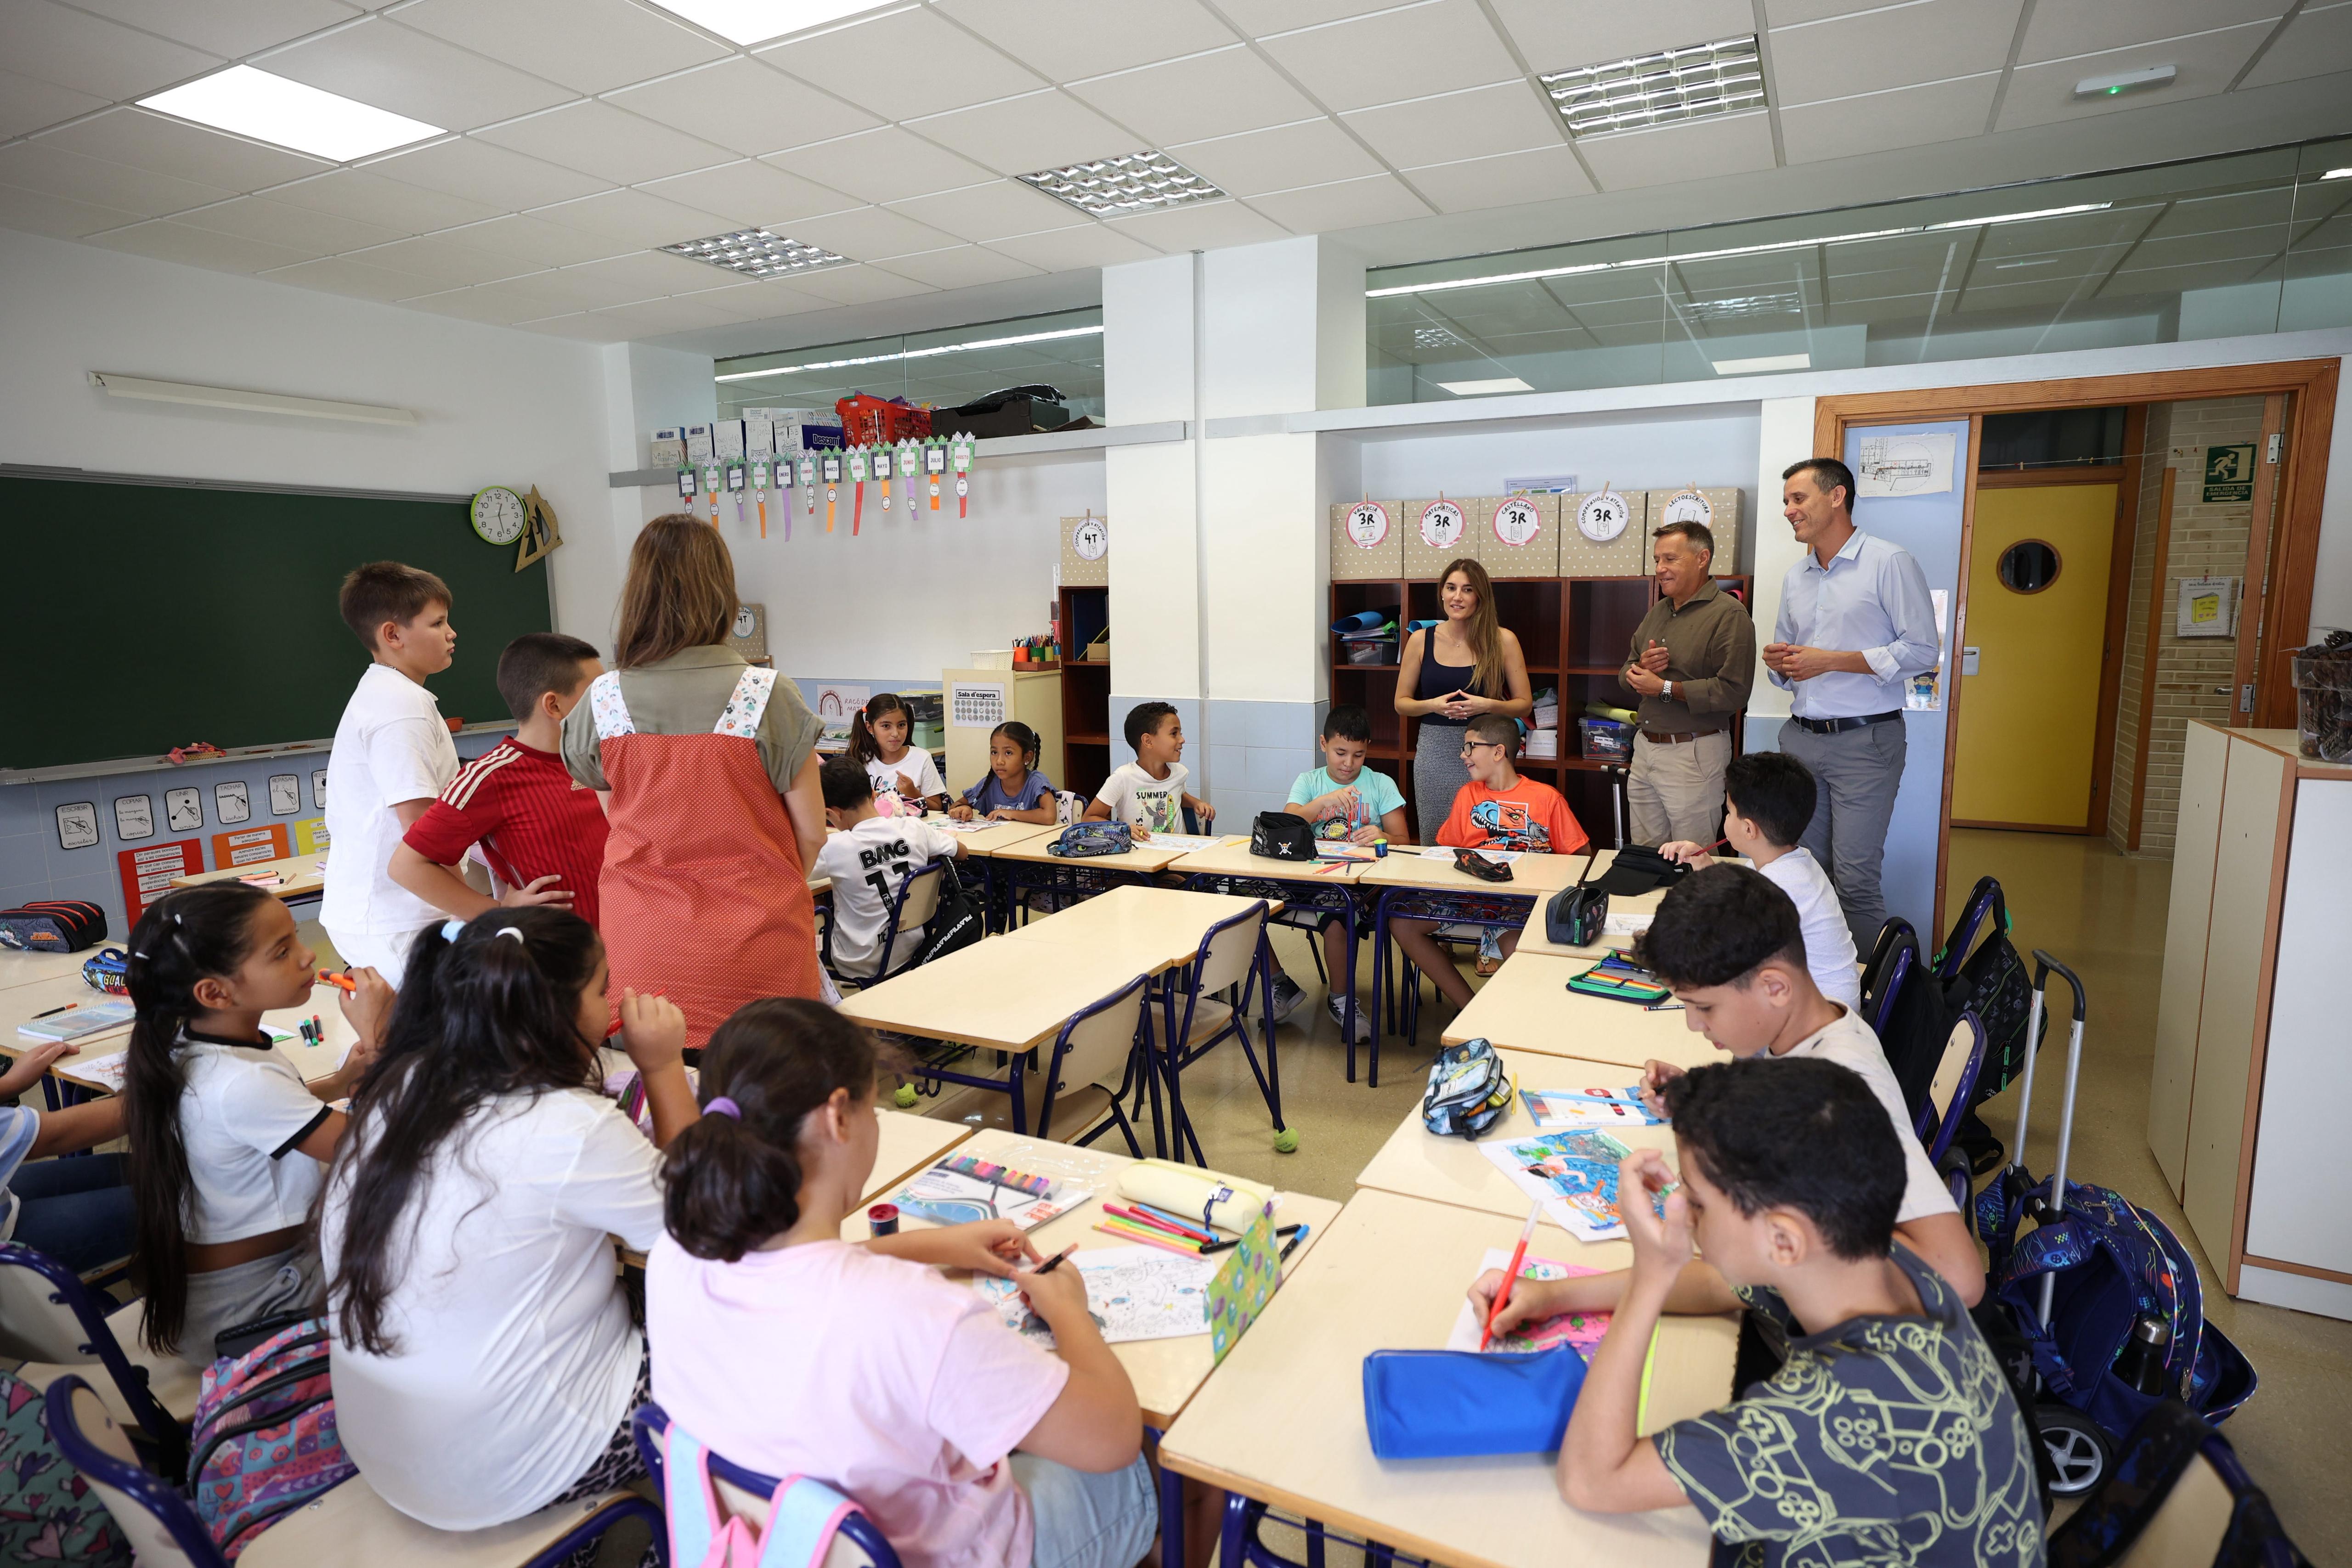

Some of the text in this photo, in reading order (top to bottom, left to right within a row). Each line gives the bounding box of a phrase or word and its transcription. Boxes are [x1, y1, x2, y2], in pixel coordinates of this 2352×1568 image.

[1502, 502, 1534, 514] CASTELLANO
[1610, 498, 1624, 519] ATENCIÓN
[1668, 494, 1710, 514] LECTOESCRITURA
[1359, 513, 1374, 525] 3R
[1434, 514, 1450, 527] 3R
[1509, 511, 1527, 524] 3R
[1593, 508, 1612, 522] 3R
[1085, 533, 1097, 544] 4T
[1094, 524, 1105, 541] ATENCIÓN
[738, 615, 747, 624] 4T
[1136, 791, 1168, 800] SUMMER
[62, 805, 88, 813] ESCRIBIR
[68, 838, 93, 846] escribir
[858, 838, 910, 870] BMG
[103, 974, 125, 987] GOAL
